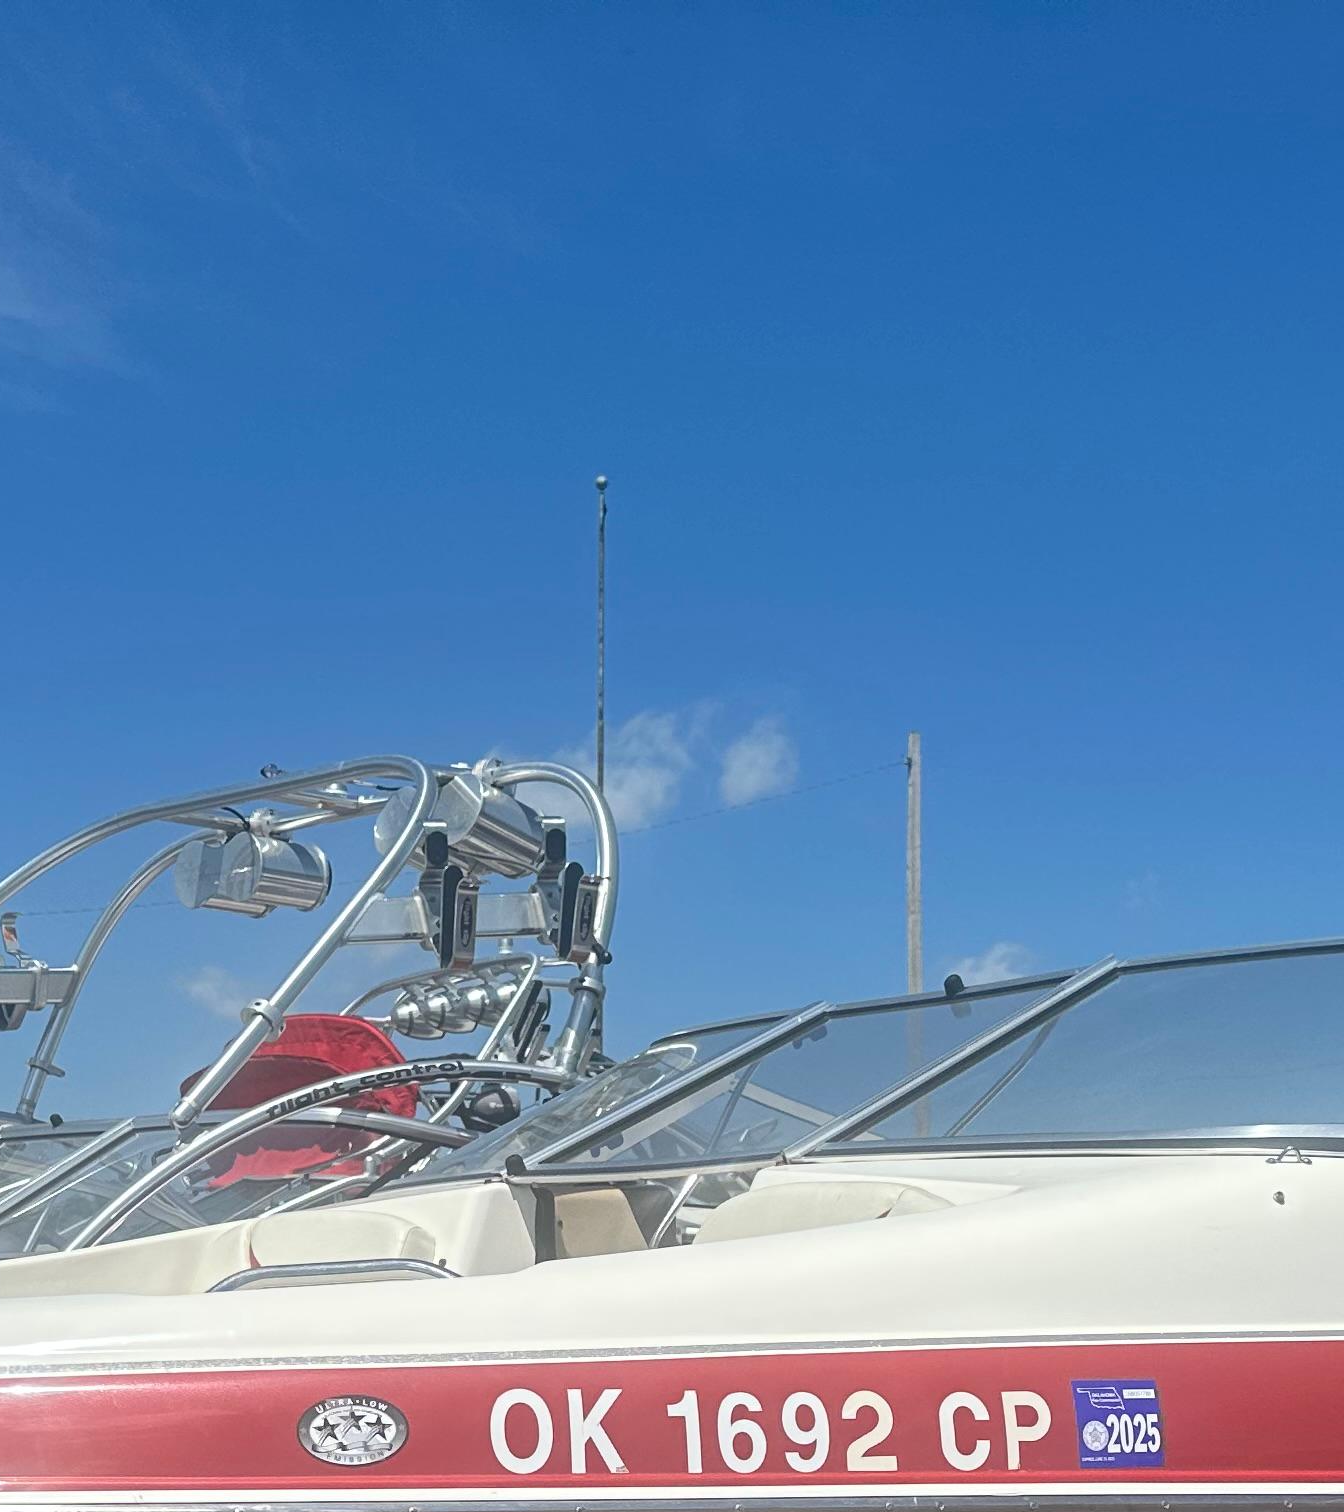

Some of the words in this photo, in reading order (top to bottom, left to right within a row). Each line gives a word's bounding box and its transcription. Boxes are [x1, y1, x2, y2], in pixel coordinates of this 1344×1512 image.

[359, 1060, 464, 1085] control
[489, 1388, 630, 1475] OK
[666, 1389, 899, 1475] 1692
[938, 1390, 1053, 1472] CP
[1106, 1413, 1161, 1453] 2025
[326, 1450, 385, 1463] EMISSION
